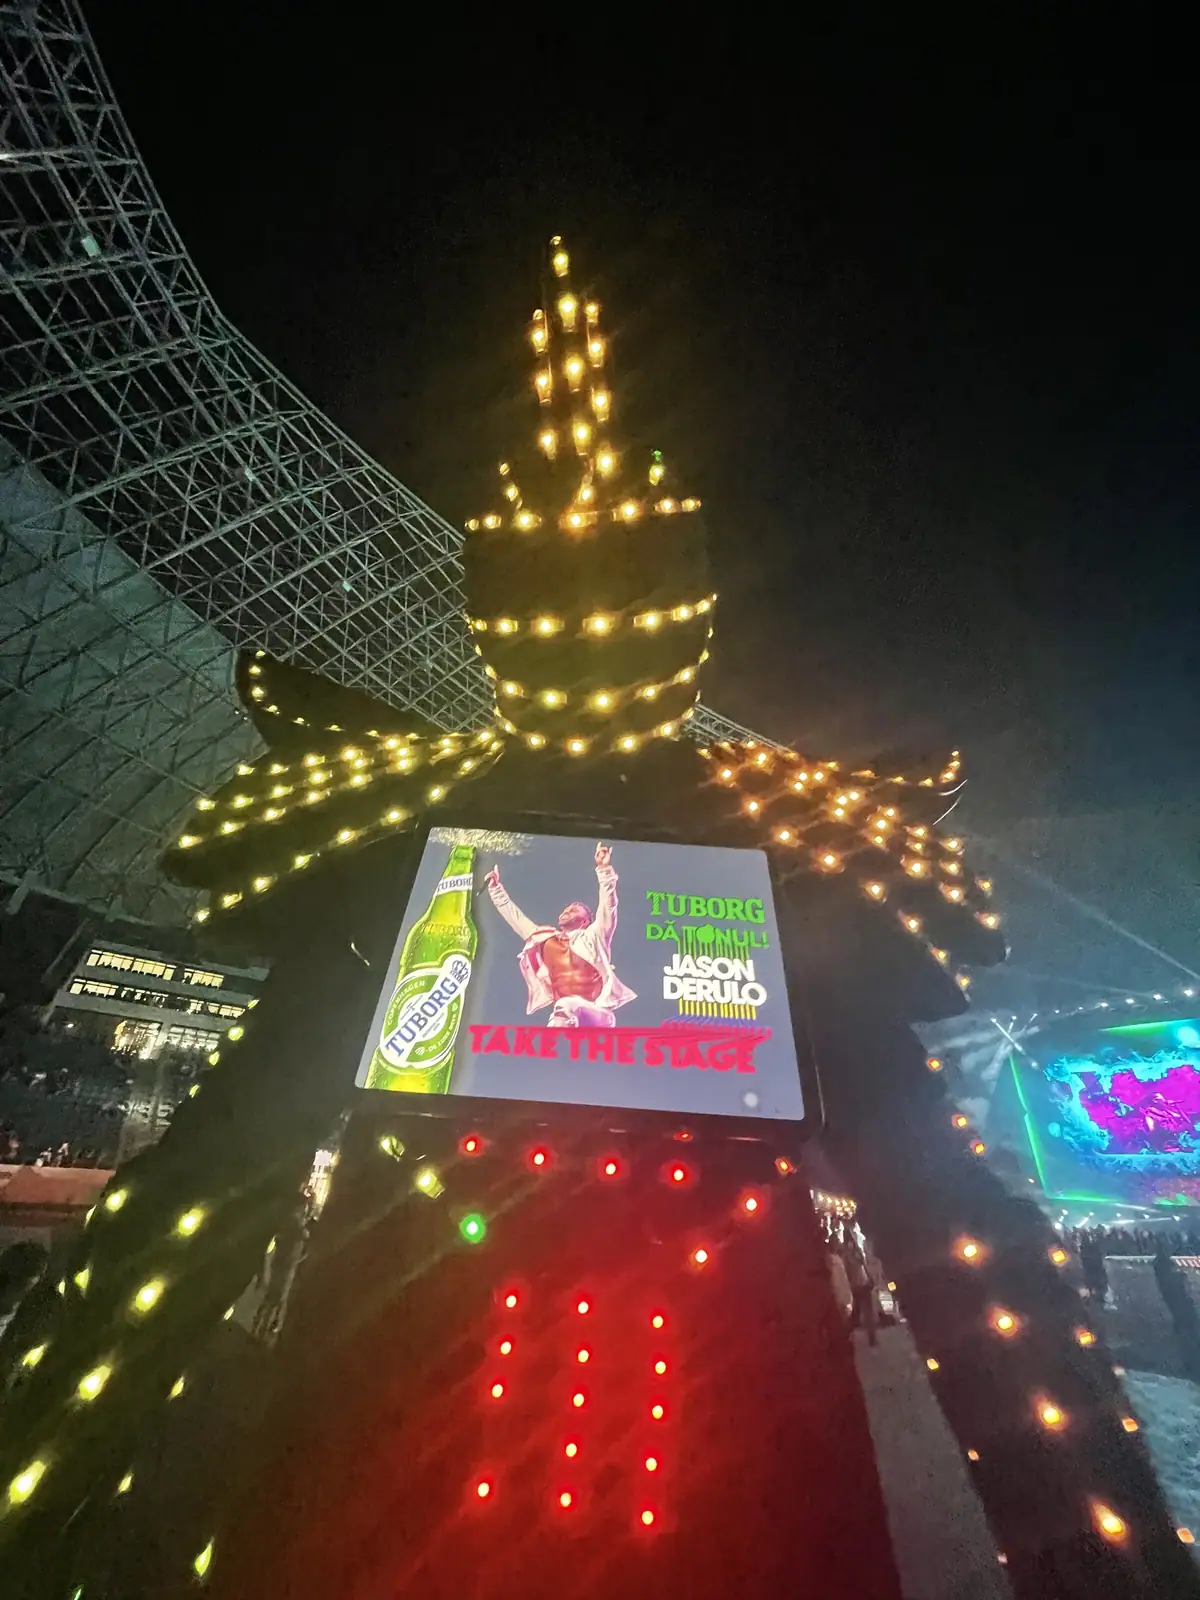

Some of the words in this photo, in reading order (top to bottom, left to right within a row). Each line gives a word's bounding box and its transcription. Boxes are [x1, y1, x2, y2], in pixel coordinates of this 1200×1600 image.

[646, 890, 765, 924] TUBORG
[646, 919, 680, 941] DĂ
[663, 953, 756, 981] JASON
[387, 980, 426, 1026] COPENHAGEN
[663, 976, 767, 1007] DERULO
[385, 976, 459, 1057] TUBORG
[468, 1025, 558, 1059] TAKE
[558, 1029, 637, 1065] THE
[644, 1033, 769, 1073] STAGE
